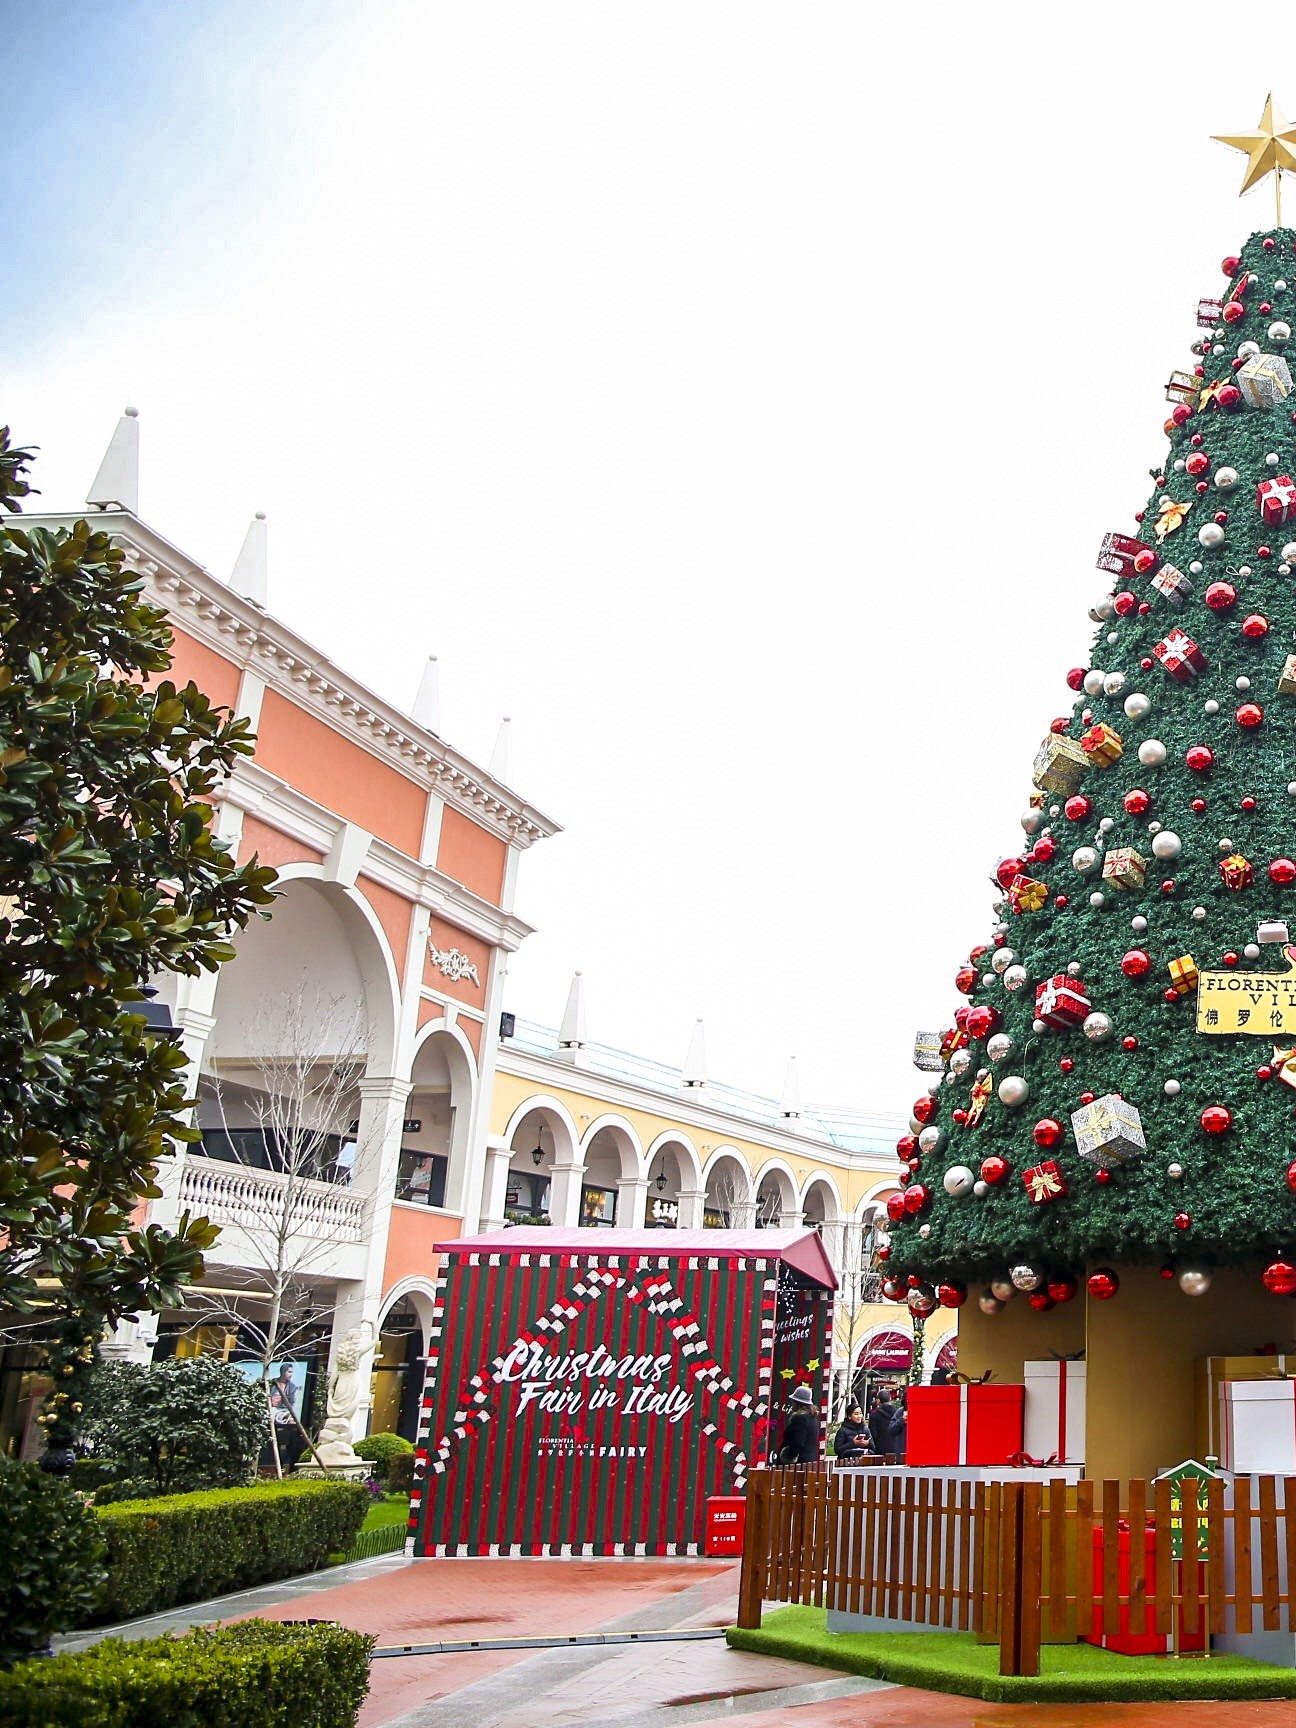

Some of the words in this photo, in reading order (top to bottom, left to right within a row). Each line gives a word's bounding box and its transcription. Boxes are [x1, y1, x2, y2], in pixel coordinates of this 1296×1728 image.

[501, 1340, 673, 1382] Christmas
[515, 1381, 585, 1418] Fair
[588, 1383, 620, 1411] in
[621, 1383, 695, 1423] Italy
[599, 1446, 648, 1457] FAIRY
